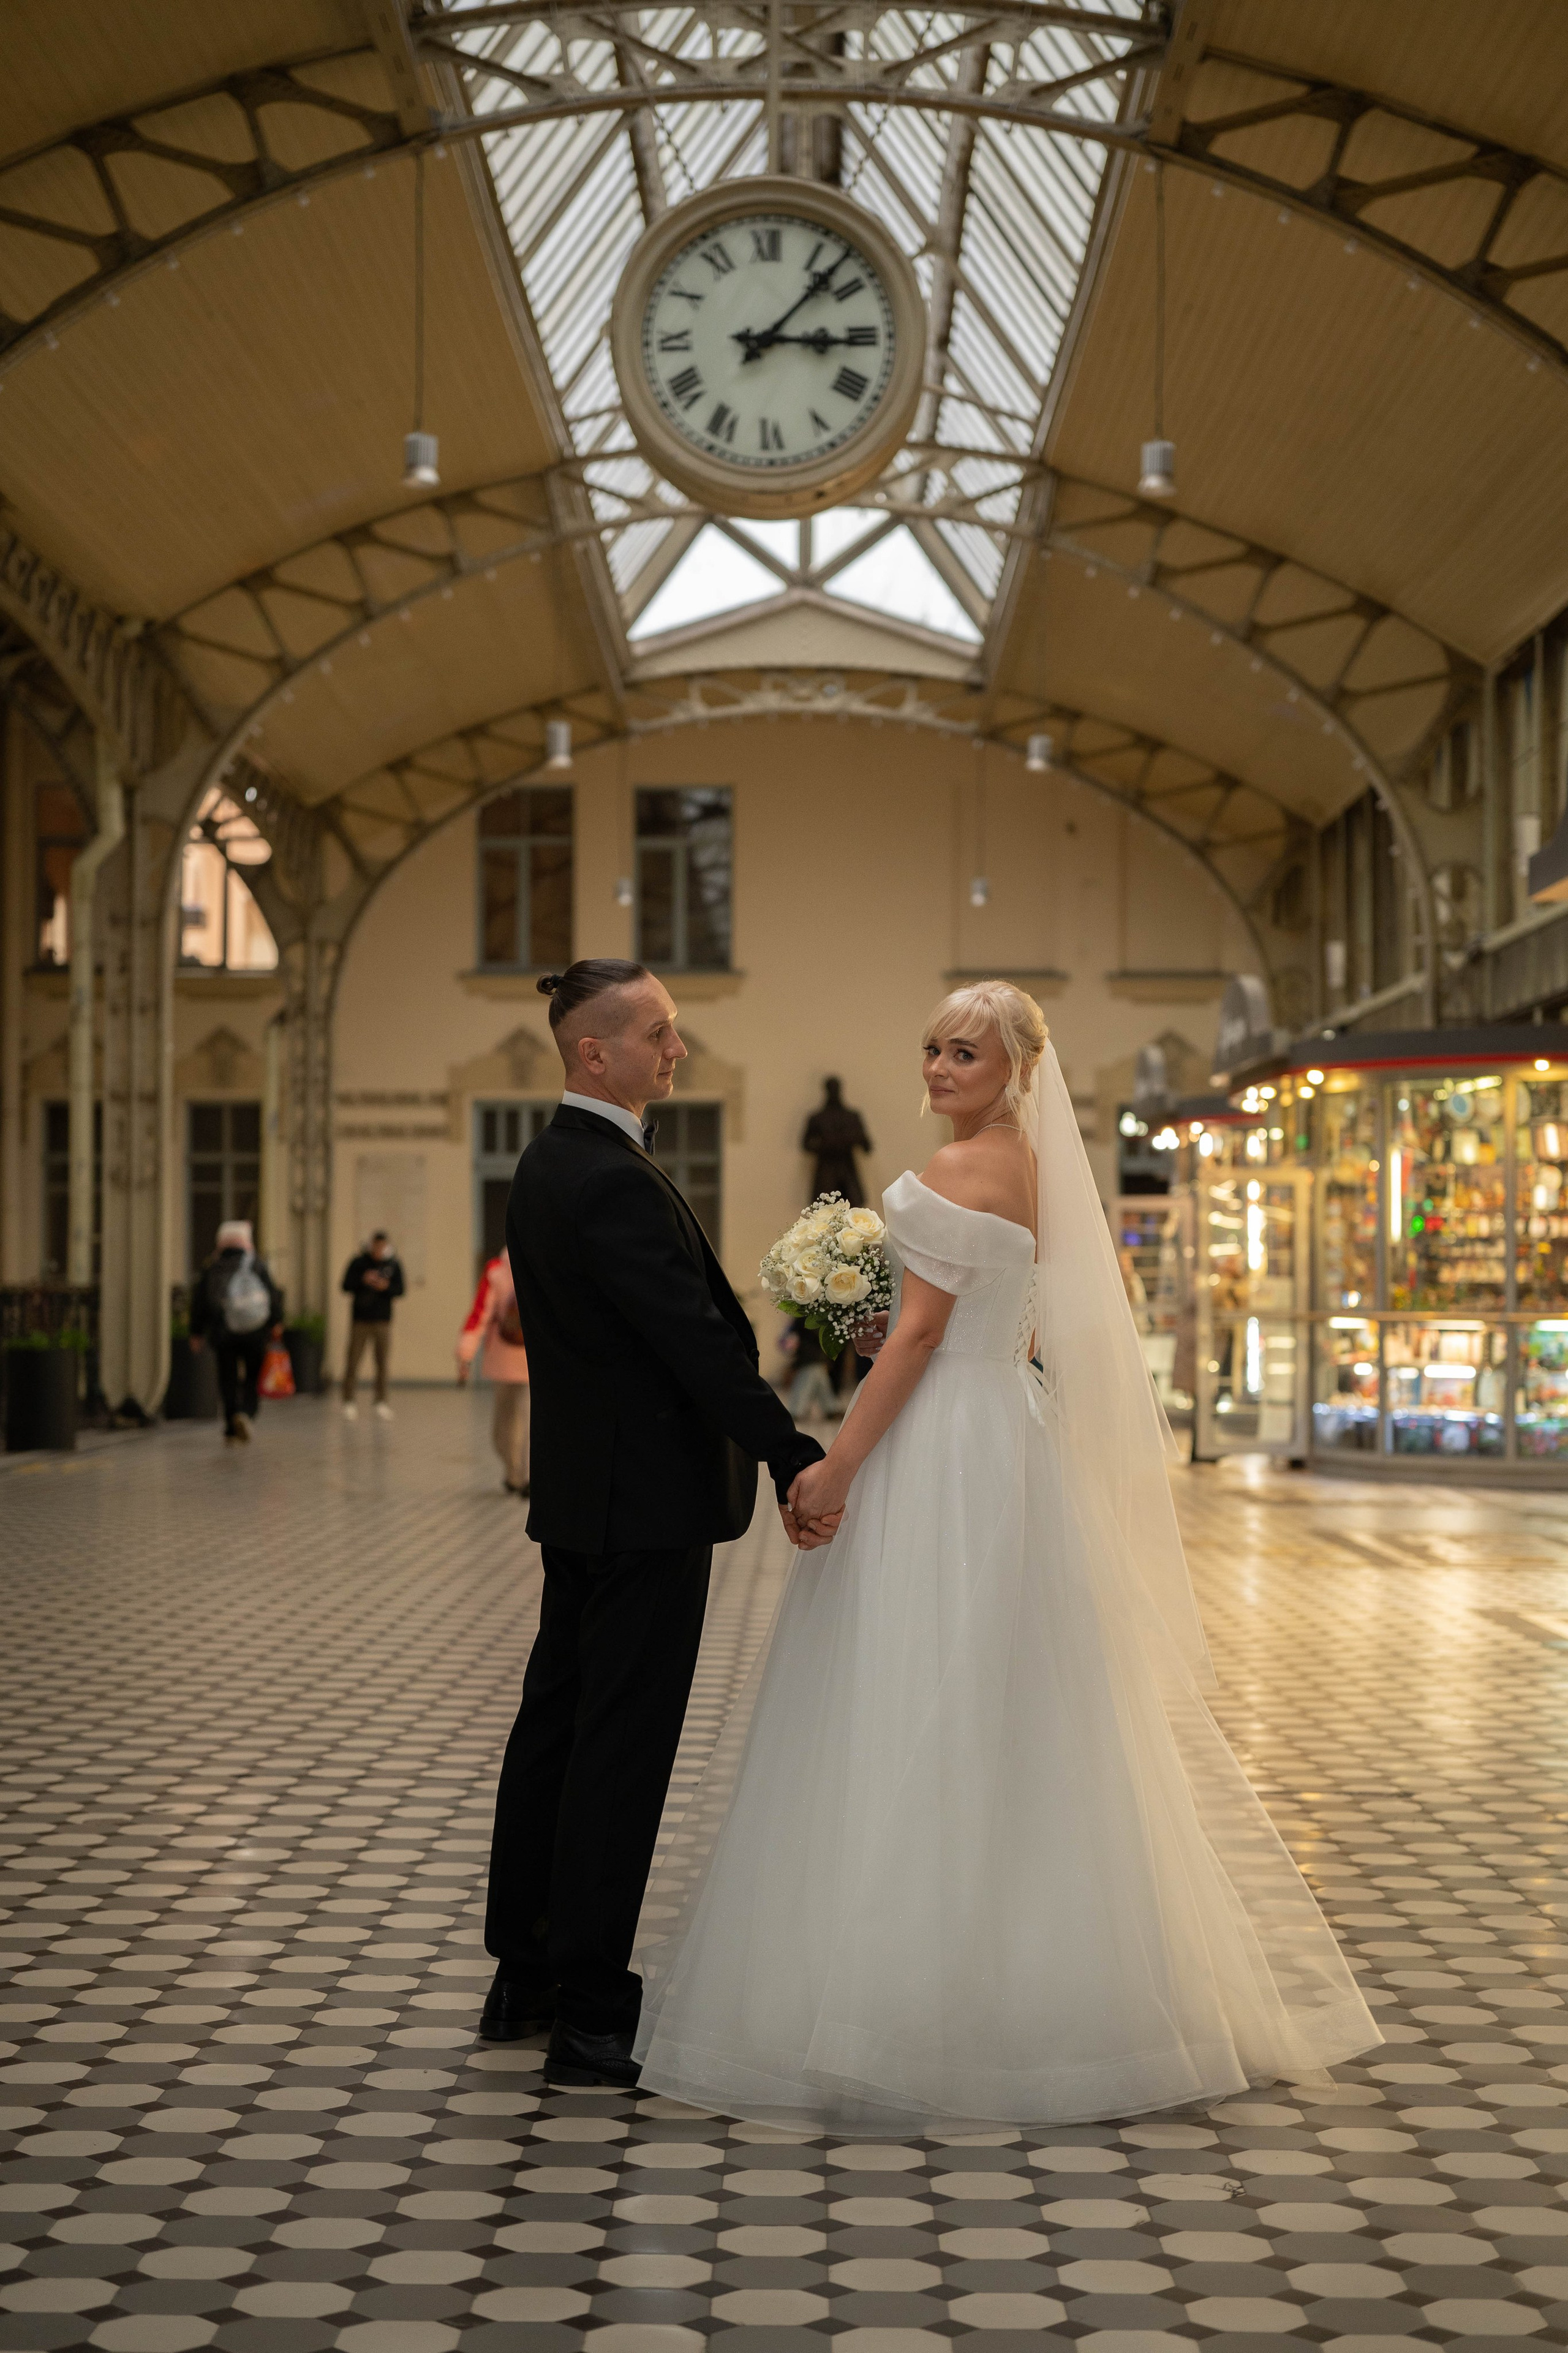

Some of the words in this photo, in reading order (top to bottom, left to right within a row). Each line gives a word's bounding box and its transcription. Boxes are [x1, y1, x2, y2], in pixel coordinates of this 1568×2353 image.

[751, 229, 782, 262] XII
[805, 243, 824, 271] I
[701, 242, 736, 281] XI
[834, 278, 865, 303] II
[658, 328, 692, 352] IX
[845, 325, 878, 347] III
[668, 366, 706, 411] VIII
[831, 366, 870, 402] IIII
[758, 417, 785, 451] VI
[808, 407, 831, 437] V
